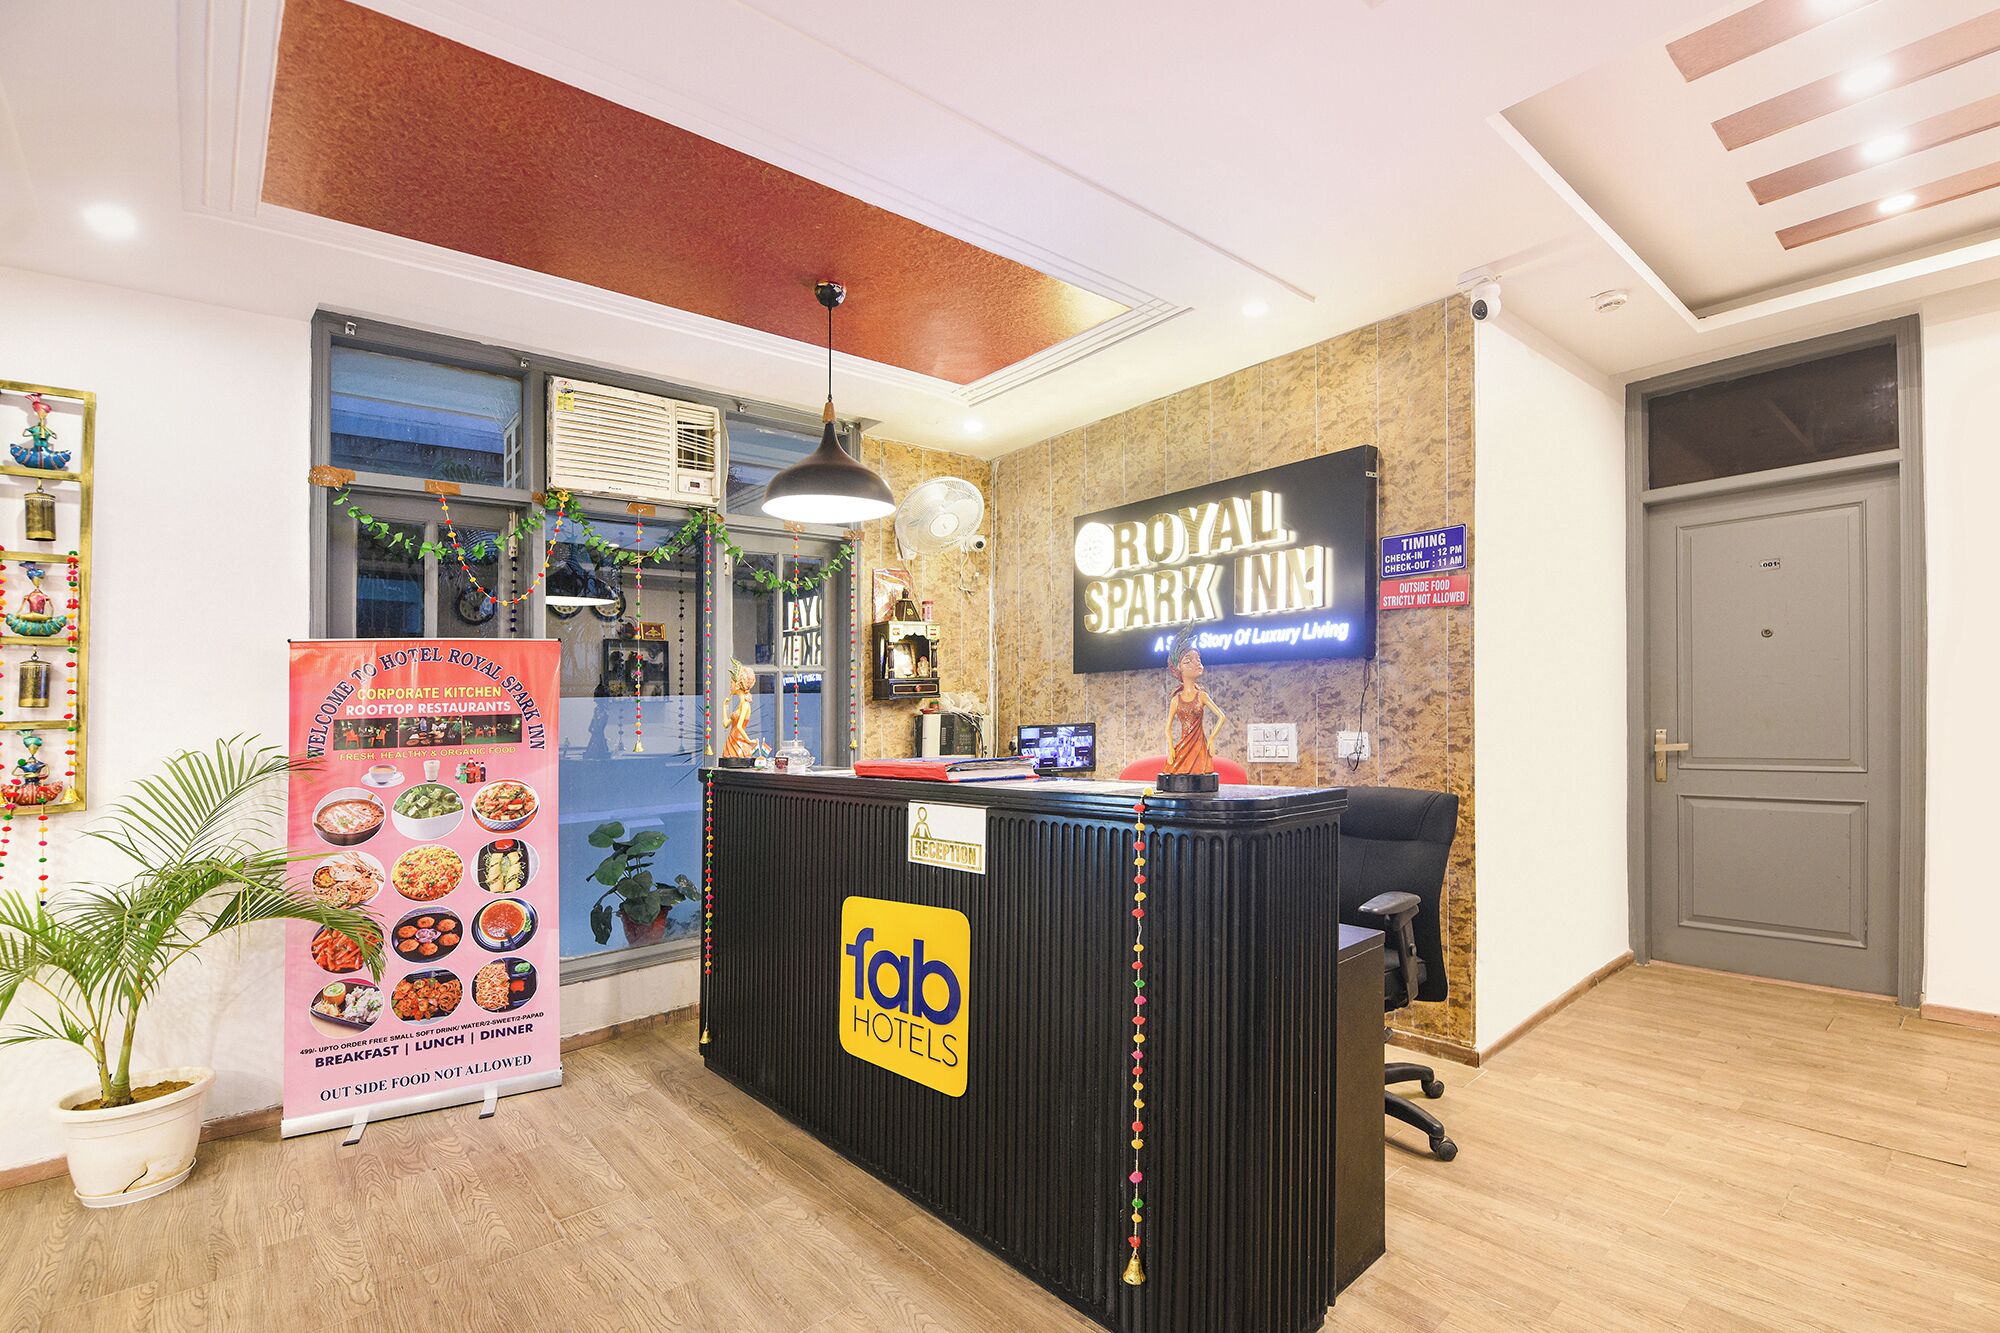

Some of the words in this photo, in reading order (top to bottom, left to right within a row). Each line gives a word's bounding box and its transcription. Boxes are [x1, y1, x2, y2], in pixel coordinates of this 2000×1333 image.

[1113, 490, 1287, 569] ROYAL
[1401, 533, 1446, 551] TIMING
[1385, 551, 1422, 563] CHECK-IN
[1438, 548, 1447, 556] 12
[1450, 545, 1462, 554] PM
[1385, 560, 1430, 573] CHECK-OUT
[1438, 558, 1446, 566] 11
[1450, 556, 1462, 565] AM
[1084, 564, 1216, 633] SPARK
[1234, 545, 1325, 616] INN
[1383, 595, 1415, 607] STRICTLY
[1417, 593, 1431, 605] NOT
[1432, 591, 1465, 604] ALLOWED
[1400, 581, 1428, 593] OUTSIDE
[1431, 580, 1450, 591] FOOD
[1154, 637, 1164, 652] A
[1199, 632, 1232, 650] Story
[1234, 628, 1252, 646] Of
[1252, 627, 1300, 645] Luxury
[1302, 620, 1349, 641] Living
[307, 680, 354, 759] WELCOME
[351, 663, 377, 683] TO
[379, 647, 442, 670] HOTEL
[448, 649, 503, 680] ROYAL
[501, 676, 541, 721] SPARK
[528, 723, 545, 750] INN
[357, 687, 439, 699] CORPORATE
[444, 687, 501, 698] KITCHEN
[346, 704, 413, 716] ROOFTOP
[418, 702, 511, 714] RESTAURANTS
[381, 750, 427, 759] HEALTHY
[440, 747, 486, 756] ORGANIC
[489, 746, 516, 754] FOOD
[914, 839, 977, 866] RECEPTION
[846, 927, 962, 1026] fab
[315, 1045, 399, 1068] BREAKFAST
[415, 1034, 464, 1051] LUNCH
[480, 1023, 534, 1040] DINNER
[319, 1045, 339, 1053] UPTO
[341, 1040, 367, 1049] ORDER
[369, 1037, 388, 1045] FREE
[390, 1033, 414, 1041] SMALL
[416, 1029, 434, 1037] SOFT
[853, 1005, 959, 1068] HOTELS
[320, 1086, 351, 1101] OUT
[354, 1080, 388, 1096] SIDE
[391, 1072, 431, 1089] FOOD
[434, 1066, 463, 1082] NOT
[465, 1054, 532, 1075] ALLOWED
